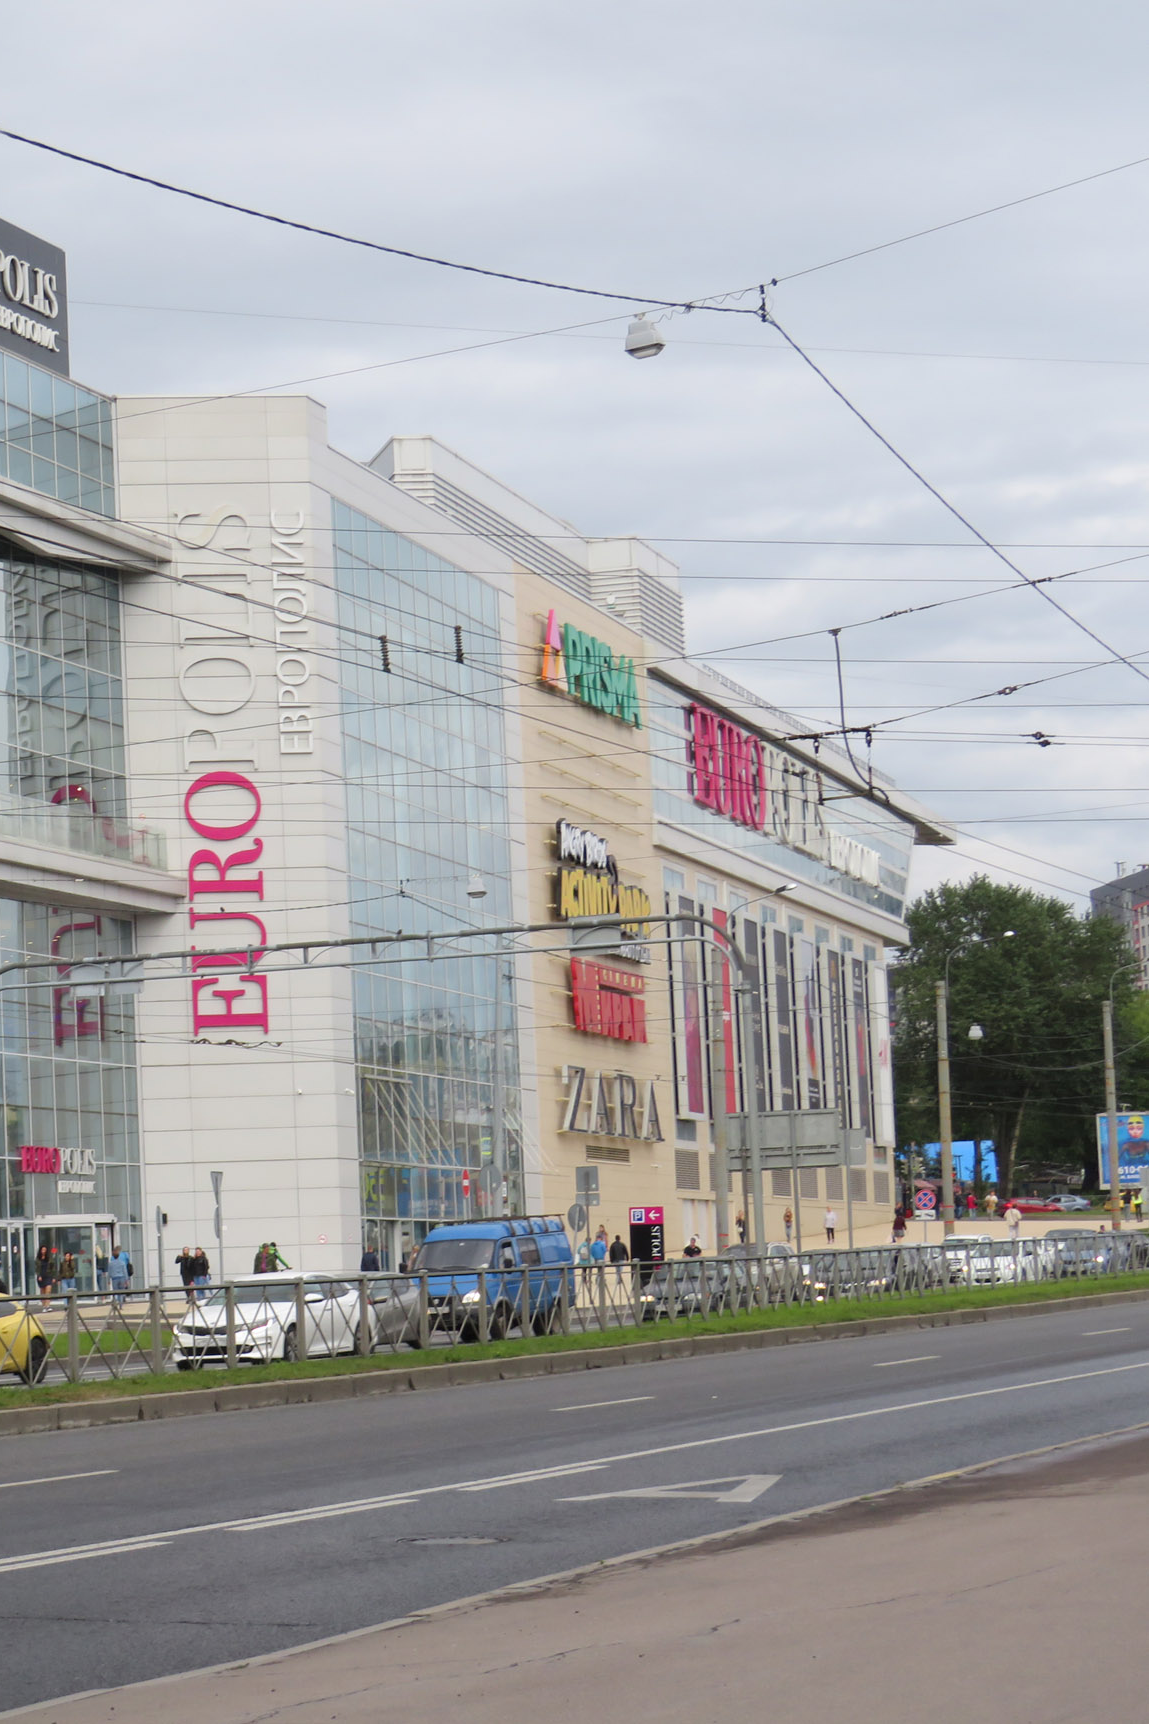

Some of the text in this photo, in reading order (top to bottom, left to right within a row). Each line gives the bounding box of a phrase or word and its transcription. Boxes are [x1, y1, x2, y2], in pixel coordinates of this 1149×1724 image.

[270, 509, 314, 755] ЕВРОПОЛИС
[563, 622, 643, 731] PRISMA
[561, 1064, 665, 1143] ZARA
